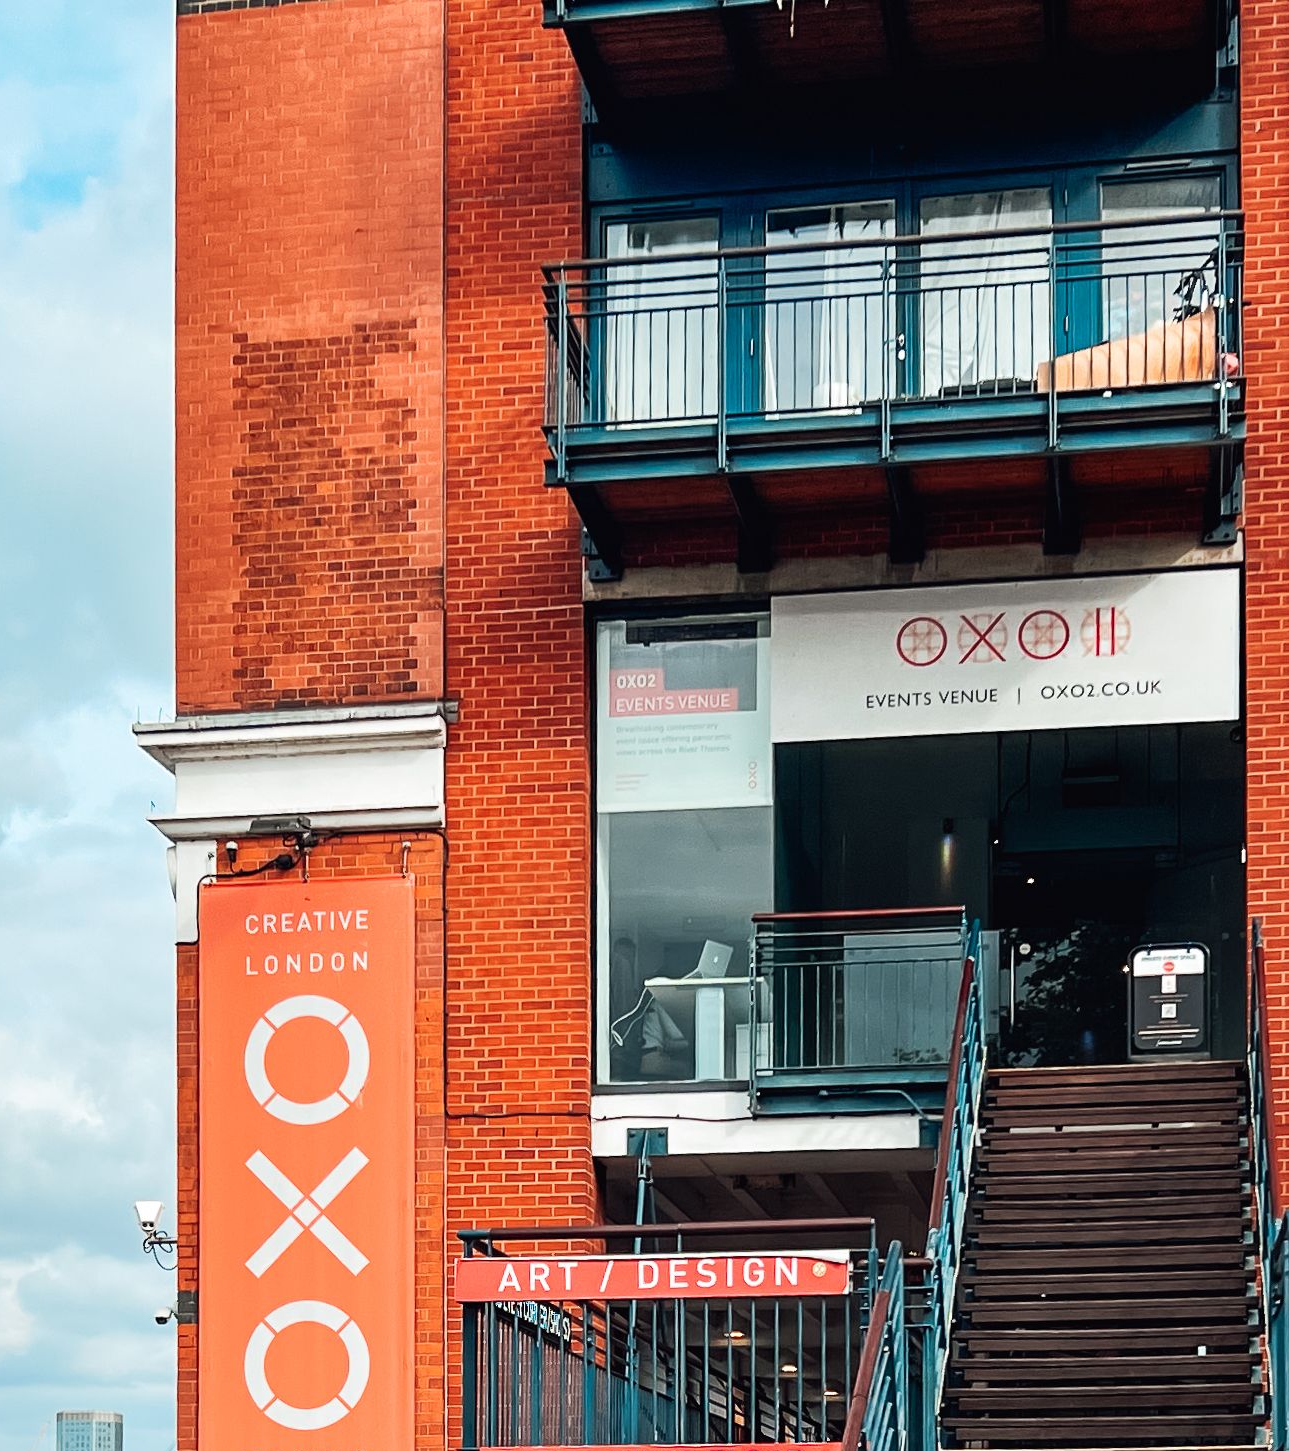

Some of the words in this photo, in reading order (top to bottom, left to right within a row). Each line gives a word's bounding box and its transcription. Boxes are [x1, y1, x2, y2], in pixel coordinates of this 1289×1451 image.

[617, 674, 655, 688] OXO2
[617, 696, 674, 712] EVENTS
[678, 694, 729, 708] VENUE
[867, 693, 931, 708] EVENTS
[939, 689, 997, 703] VENUE
[1041, 681, 1163, 699] OXO2.CO.UK
[246, 910, 368, 933] CREATIVE
[247, 951, 367, 975] LONDON
[499, 1262, 577, 1291] ART
[600, 1261, 614, 1292] /
[638, 1257, 798, 1289] DESIGN
